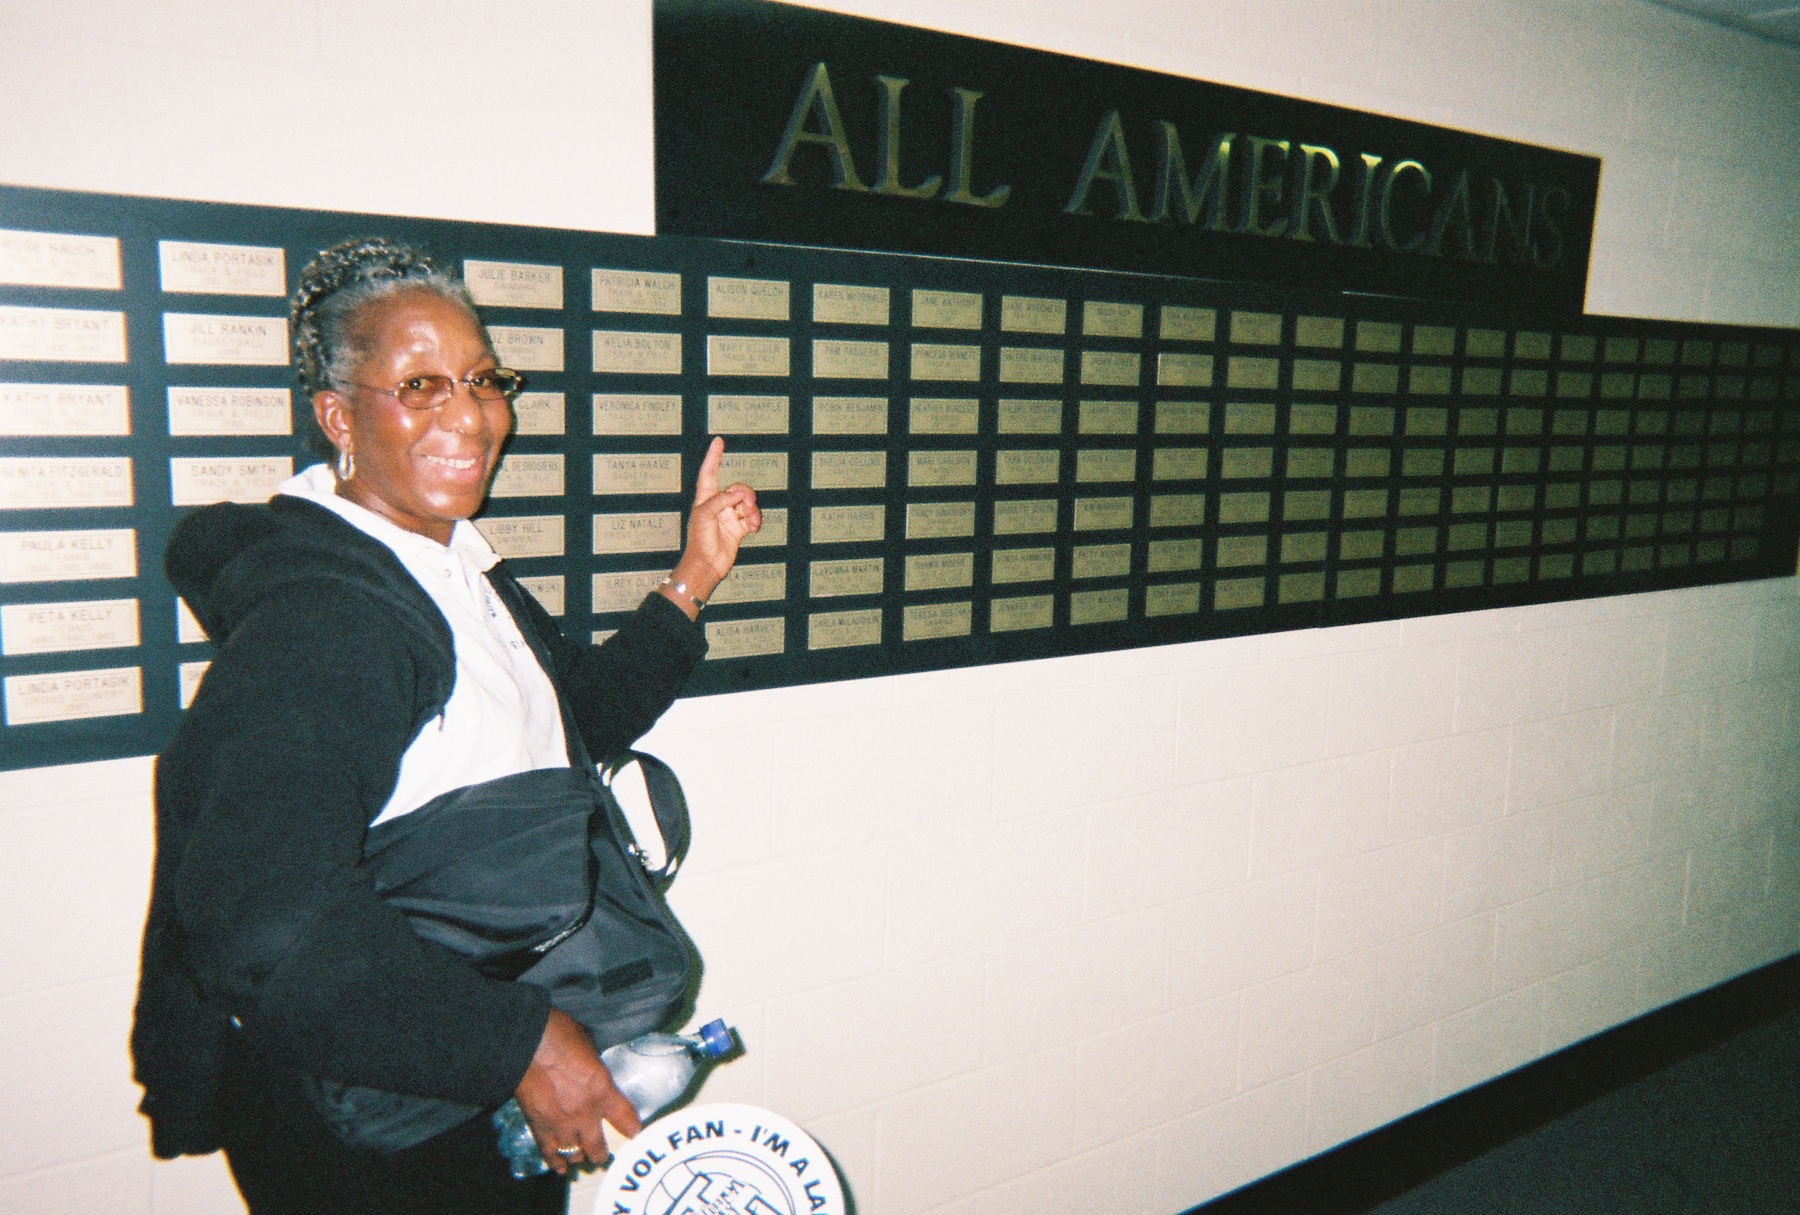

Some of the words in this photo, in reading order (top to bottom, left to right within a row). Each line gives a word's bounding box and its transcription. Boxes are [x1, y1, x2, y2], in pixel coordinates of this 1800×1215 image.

[761, 61, 1012, 207] ALL
[1063, 108, 1571, 268] AMERICANS
[171, 250, 209, 264] LINDA
[478, 268, 506, 282] JULIE
[510, 269, 552, 283] BARKER
[189, 322, 216, 335] JILL
[220, 323, 268, 337] RANKIN
[507, 333, 545, 345] BROWN
[177, 395, 228, 407] VANESSA
[231, 395, 285, 408] ROBINSON
[50, 465, 124, 478] FITZGERALD
[191, 464, 233, 477] SANDY
[239, 464, 277, 477] SMITH
[521, 523, 545, 535] HILL
[20, 538, 66, 552] PAULA
[70, 538, 114, 551] KELLY
[70, 608, 114, 622] KELLY
[17, 681, 59, 696] LINDA
[620, 1149, 667, 1191] VOL
[667, 1120, 725, 1150] FAN
[750, 1125, 791, 1157] I'M
[789, 1157, 810, 1177] A
